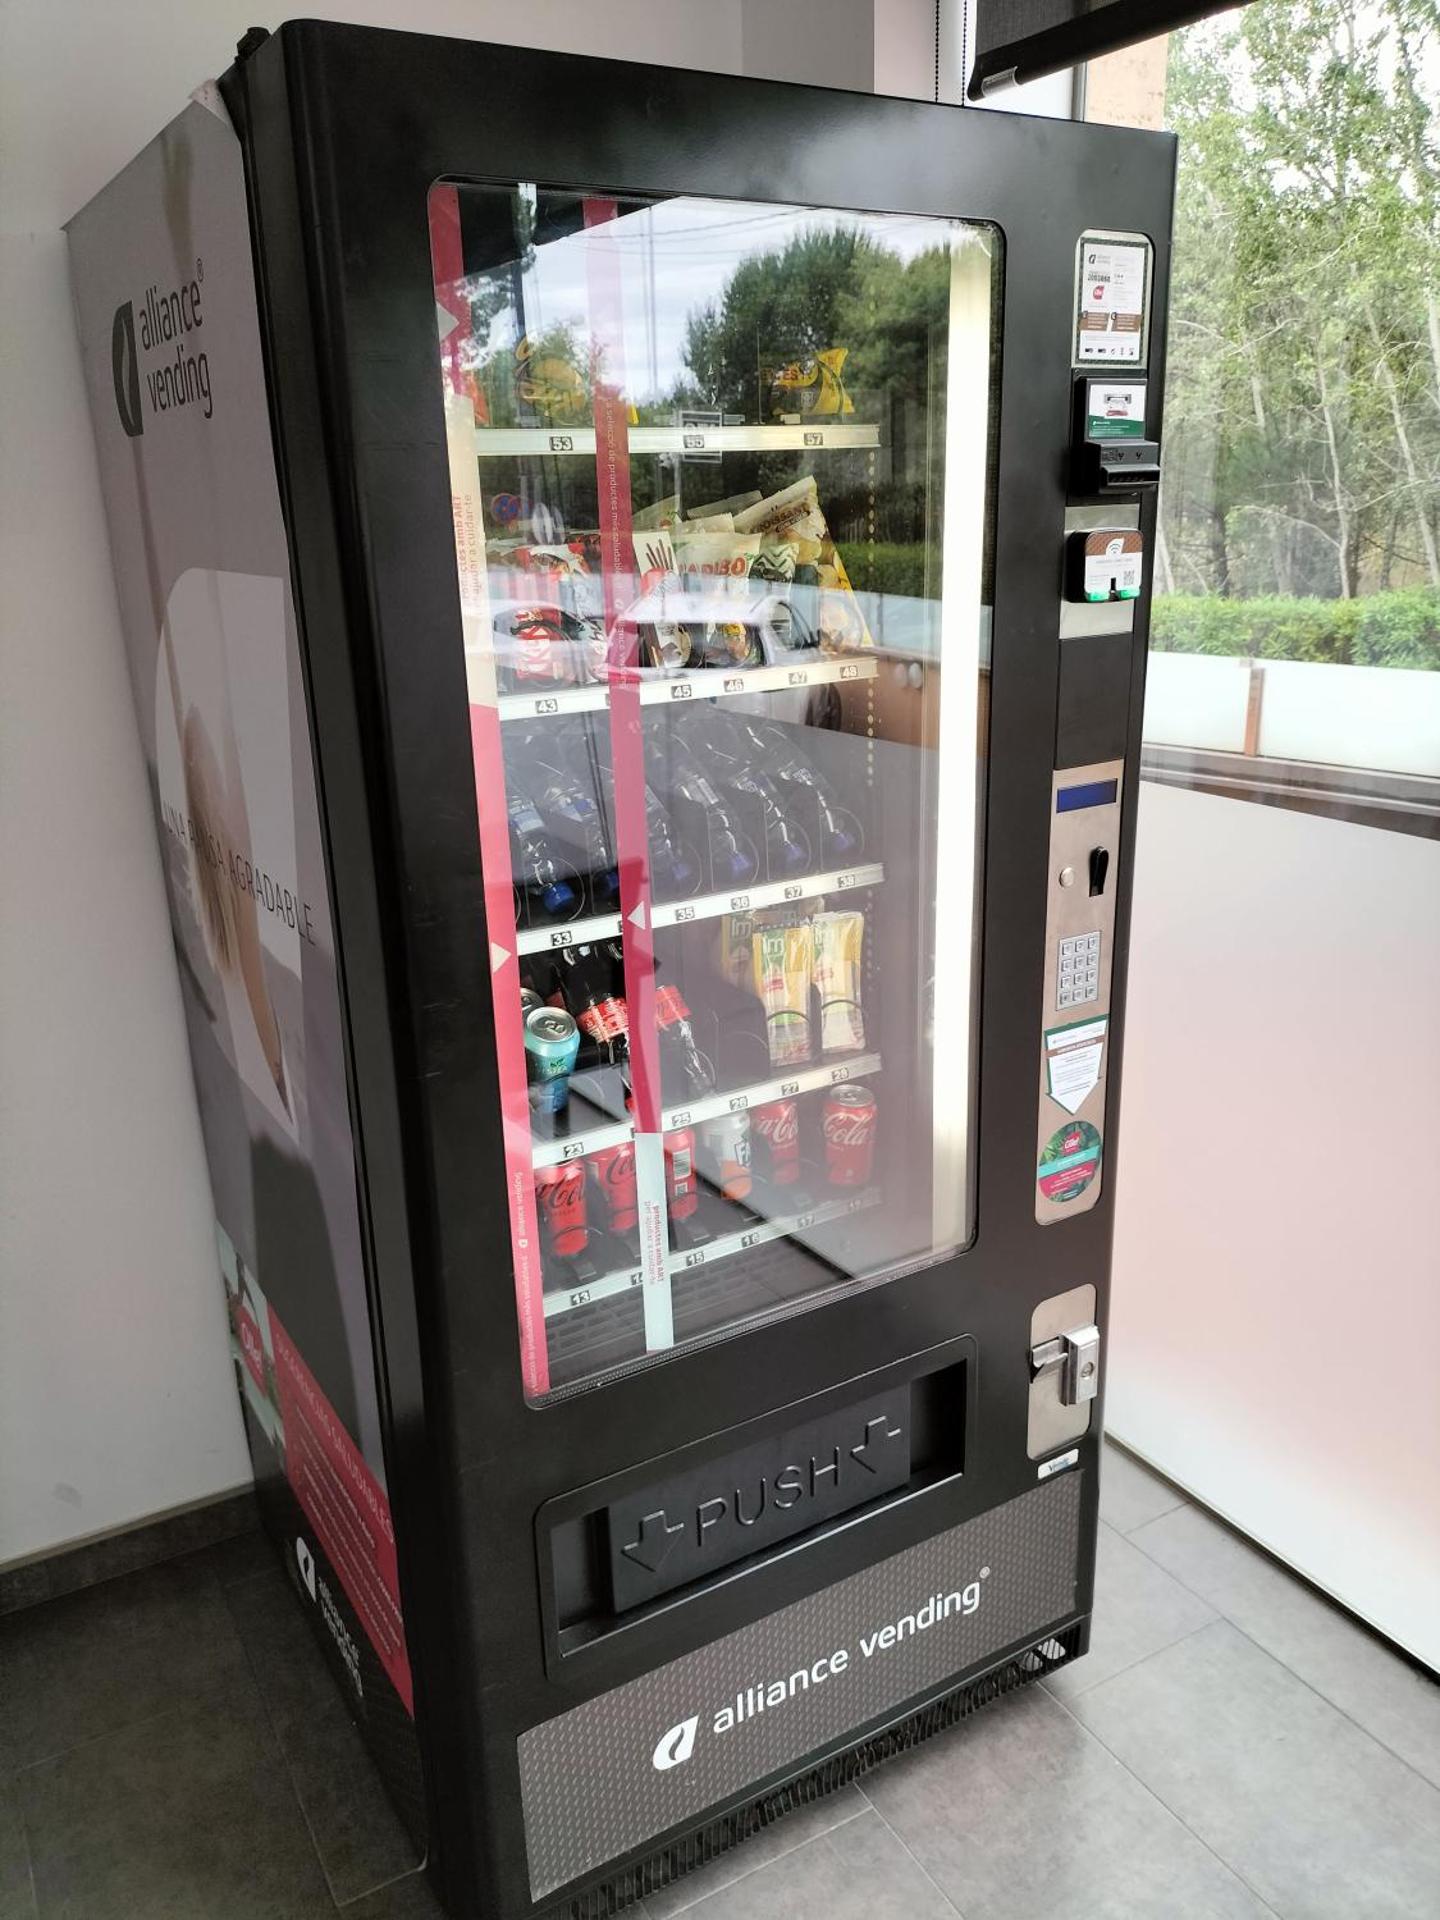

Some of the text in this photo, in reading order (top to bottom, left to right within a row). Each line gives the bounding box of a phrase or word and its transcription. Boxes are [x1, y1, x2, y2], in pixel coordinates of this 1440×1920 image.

[146, 342, 213, 419] vending
[551, 437, 572, 450] 53
[684, 435, 704, 448] 55
[804, 432, 823, 445] 57
[455, 520, 466, 547] amb
[672, 685, 692, 698] 45
[537, 699, 558, 713] 43
[228, 849, 317, 947] AGRADABLE
[785, 886, 802, 899] 37
[676, 907, 695, 920] 35
[551, 930, 572, 946] 33
[564, 1142, 584, 1157] 23
[570, 1290, 590, 1306] 13
[696, 1445, 841, 1547] PUSH
[713, 1648, 848, 1734] alliance
